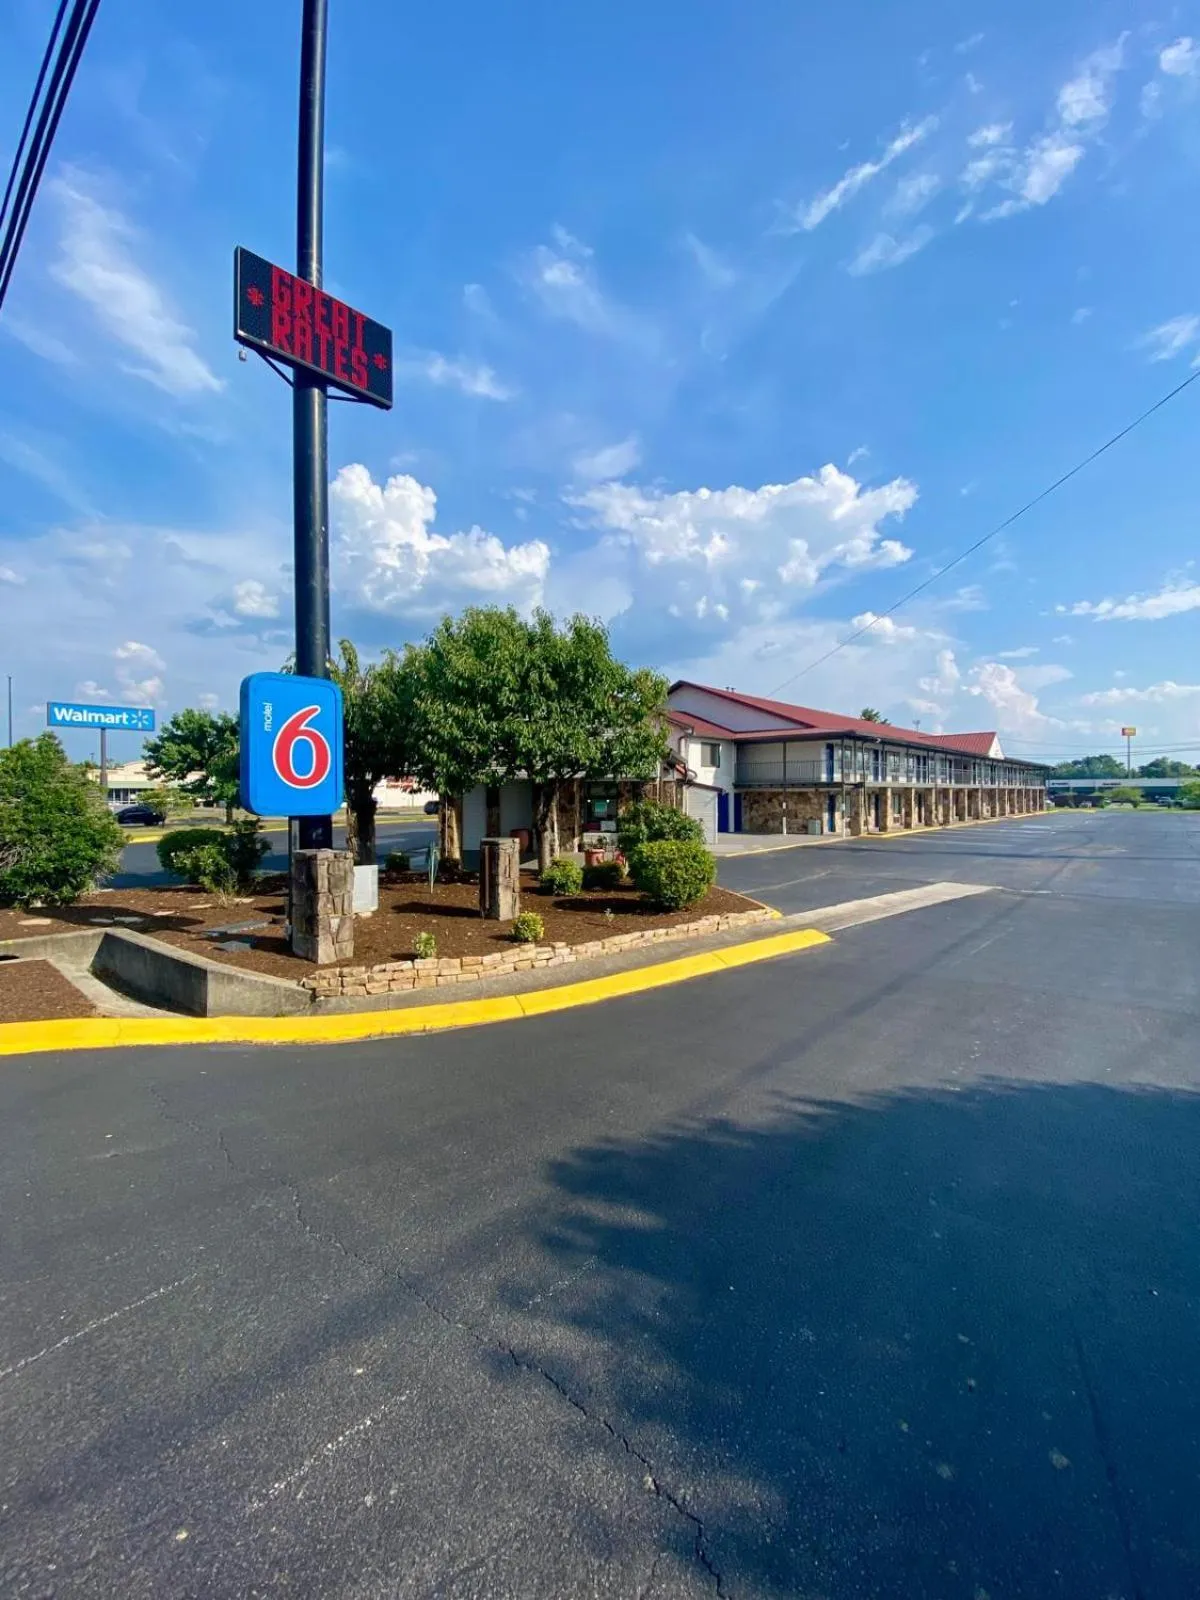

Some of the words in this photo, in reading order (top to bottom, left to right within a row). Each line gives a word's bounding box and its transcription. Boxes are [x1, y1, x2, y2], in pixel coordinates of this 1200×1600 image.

[271, 265, 367, 351] GREAT
[272, 306, 369, 391] RATES
[53, 706, 129, 725] Walmart
[262, 702, 273, 732] motel
[272, 704, 332, 789] 6
